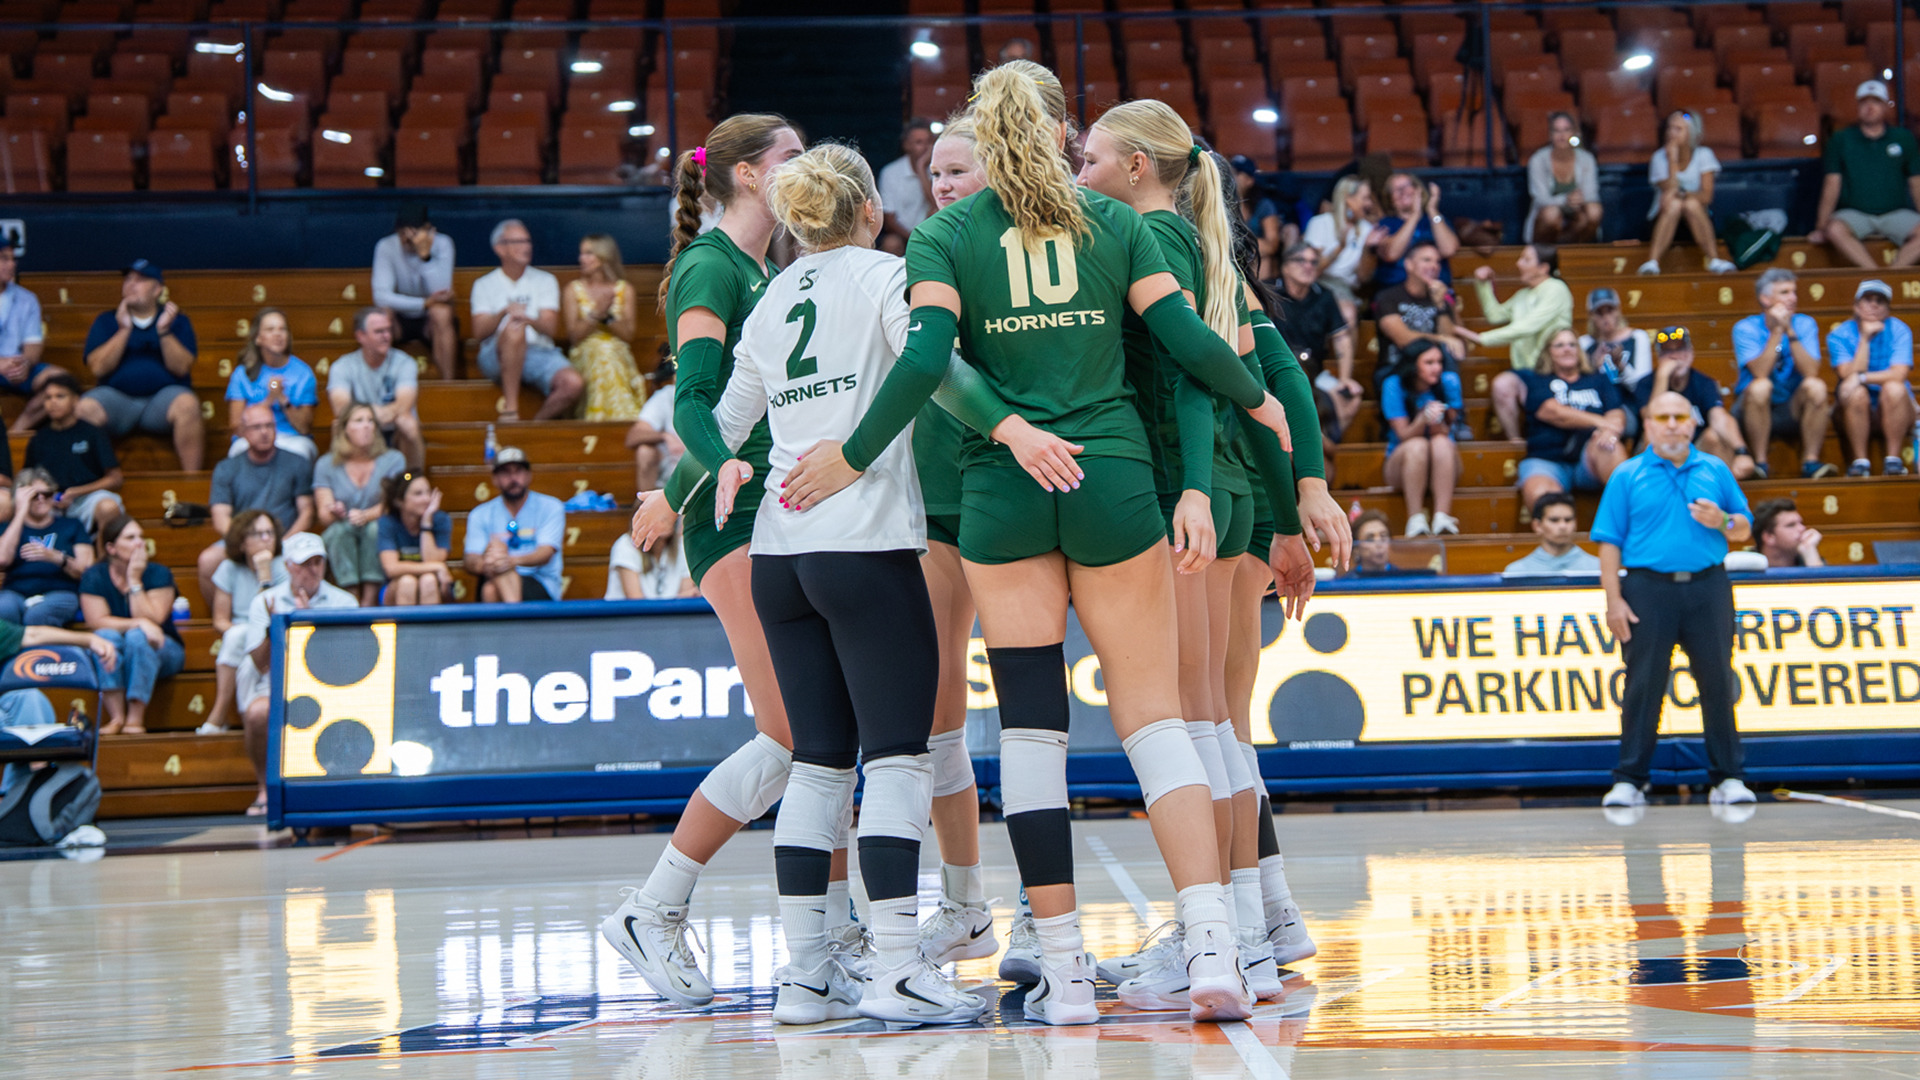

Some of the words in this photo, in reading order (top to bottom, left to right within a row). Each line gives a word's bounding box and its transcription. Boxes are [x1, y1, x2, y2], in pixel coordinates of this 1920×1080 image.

[1000, 224, 1079, 308] 10
[1613, 256, 1626, 274] 7
[253, 284, 266, 302] 3
[342, 284, 356, 300] 4
[1628, 289, 1642, 308] 7
[236, 318, 249, 336] 3
[328, 317, 343, 334] 4
[985, 309, 1106, 334] HORNETS
[785, 298, 818, 381] 2
[218, 358, 231, 377] 3
[316, 356, 329, 374] 4
[769, 373, 857, 408] HORNETS
[202, 400, 214, 418] 3
[582, 435, 598, 453] 7
[475, 482, 490, 501] 6
[1823, 494, 1838, 515] 8
[566, 527, 581, 545] 7
[1848, 541, 1864, 561] 8
[1413, 616, 1496, 658] WE
[1514, 614, 1619, 656] HAV
[1735, 606, 1914, 650] RPORT
[35, 661, 76, 676] WAVES
[1668, 662, 1920, 708] CVERED
[188, 694, 204, 714] 4
[164, 754, 181, 776] 4
